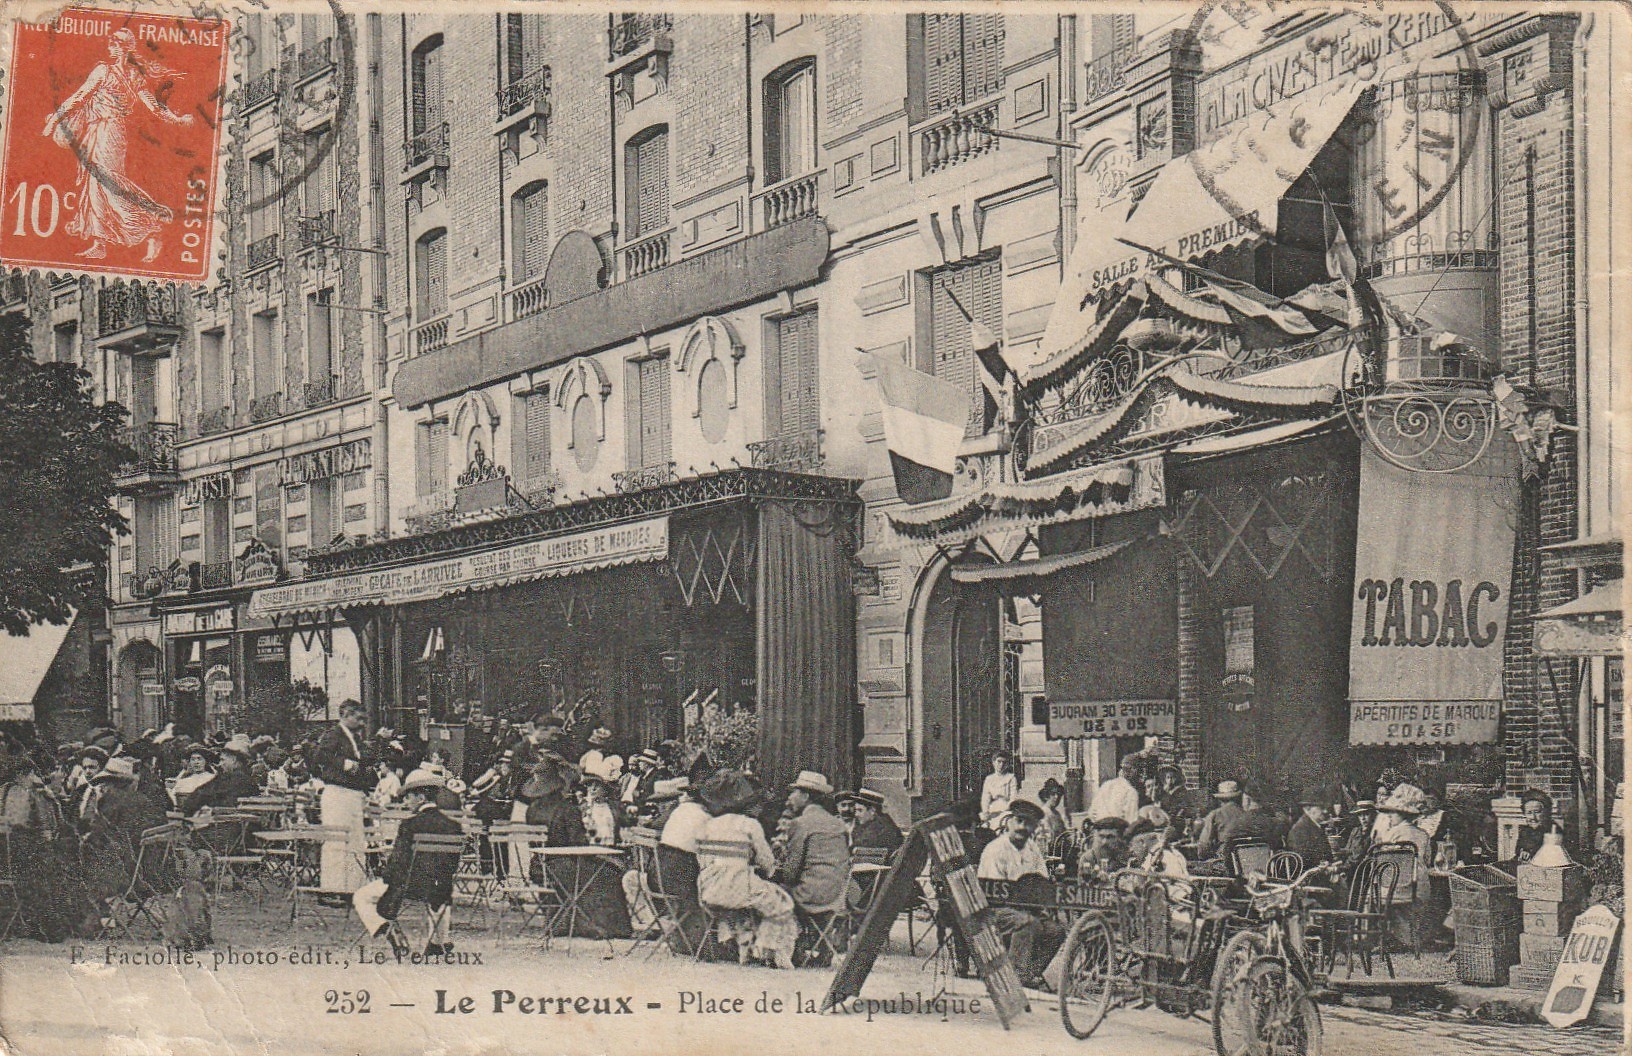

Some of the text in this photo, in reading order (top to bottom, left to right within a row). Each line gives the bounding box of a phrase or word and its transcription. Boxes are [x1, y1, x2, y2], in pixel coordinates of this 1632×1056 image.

[138, 24, 219, 47] FRANÇAISE
[10, 181, 60, 238] 10
[179, 178, 207, 264] POSTES
[1092, 256, 1139, 290] SALLE
[1178, 209, 1261, 258] PREMIER
[547, 525, 652, 561] LIQUEURS DE MARQUES
[1358, 577, 1500, 648] TABAC
[1353, 702, 1496, 722] APÉRITIFS DE MARQUE
[1387, 723, 1412, 738] 20
[1562, 932, 1608, 964] KUB
